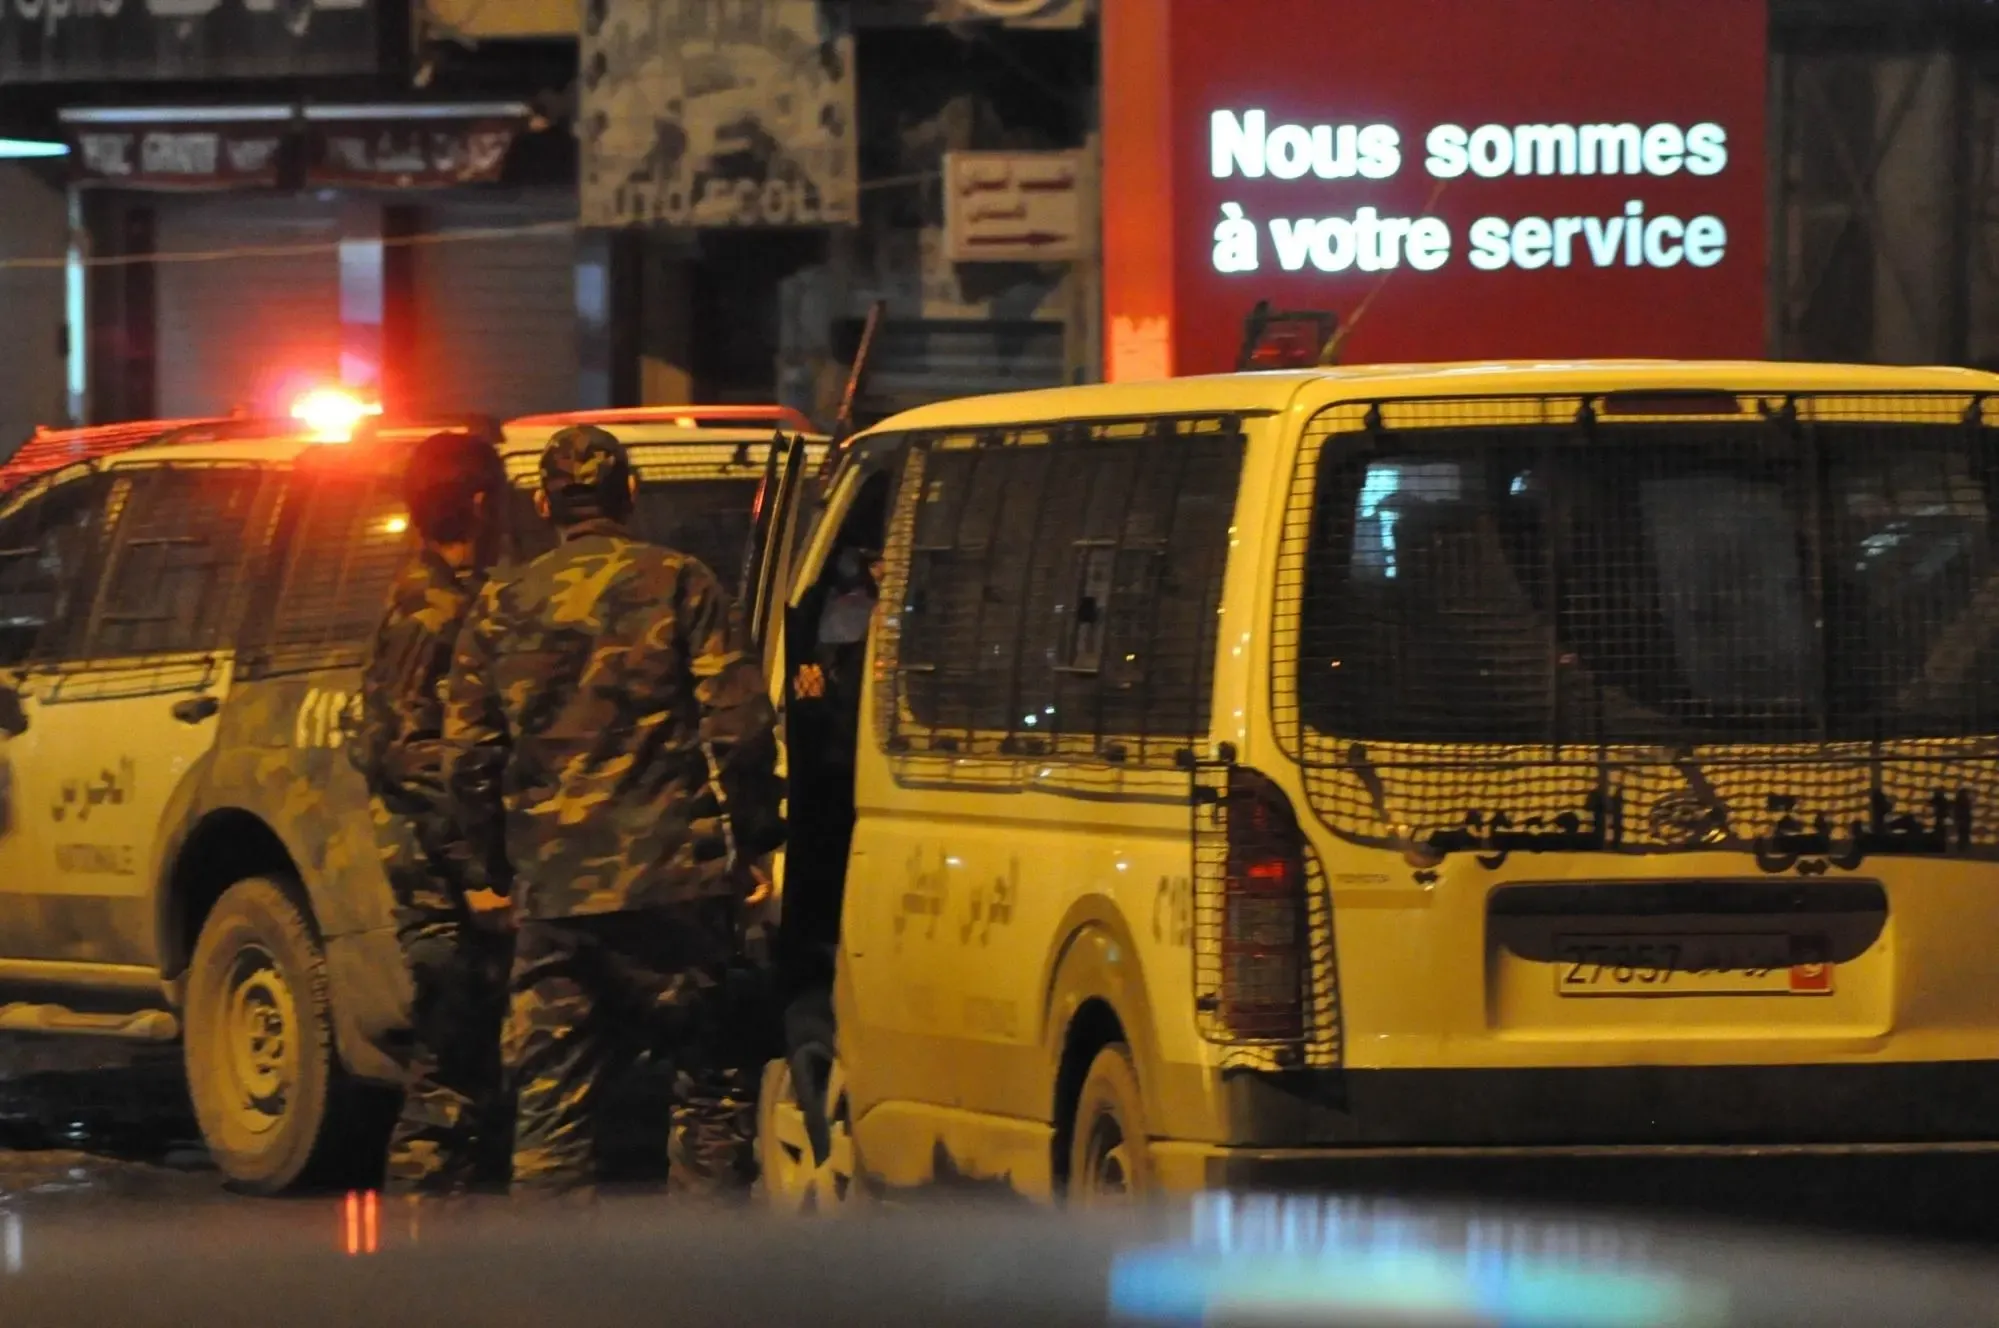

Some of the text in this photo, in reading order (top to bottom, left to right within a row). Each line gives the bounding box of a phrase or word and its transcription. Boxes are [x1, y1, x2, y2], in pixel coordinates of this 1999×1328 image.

[1211, 109, 1728, 178] Nous sommes
[1213, 200, 1727, 273] à votre service
